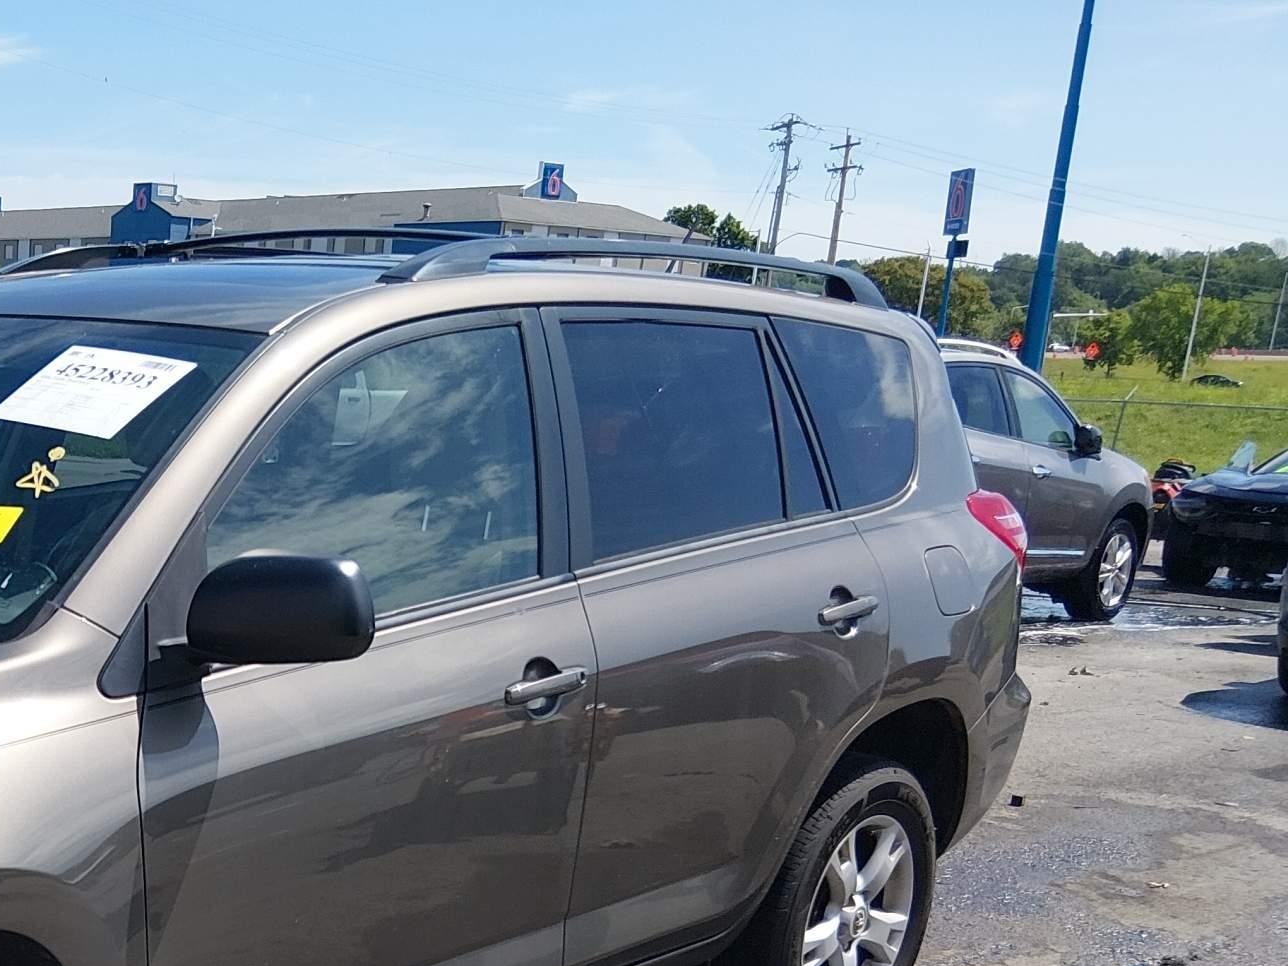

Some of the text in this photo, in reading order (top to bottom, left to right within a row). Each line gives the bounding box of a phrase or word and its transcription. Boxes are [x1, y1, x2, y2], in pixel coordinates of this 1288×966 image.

[548, 168, 561, 196] 6
[136, 187, 147, 211] 6
[950, 173, 965, 219] 6
[55, 362, 158, 389] 45228393
